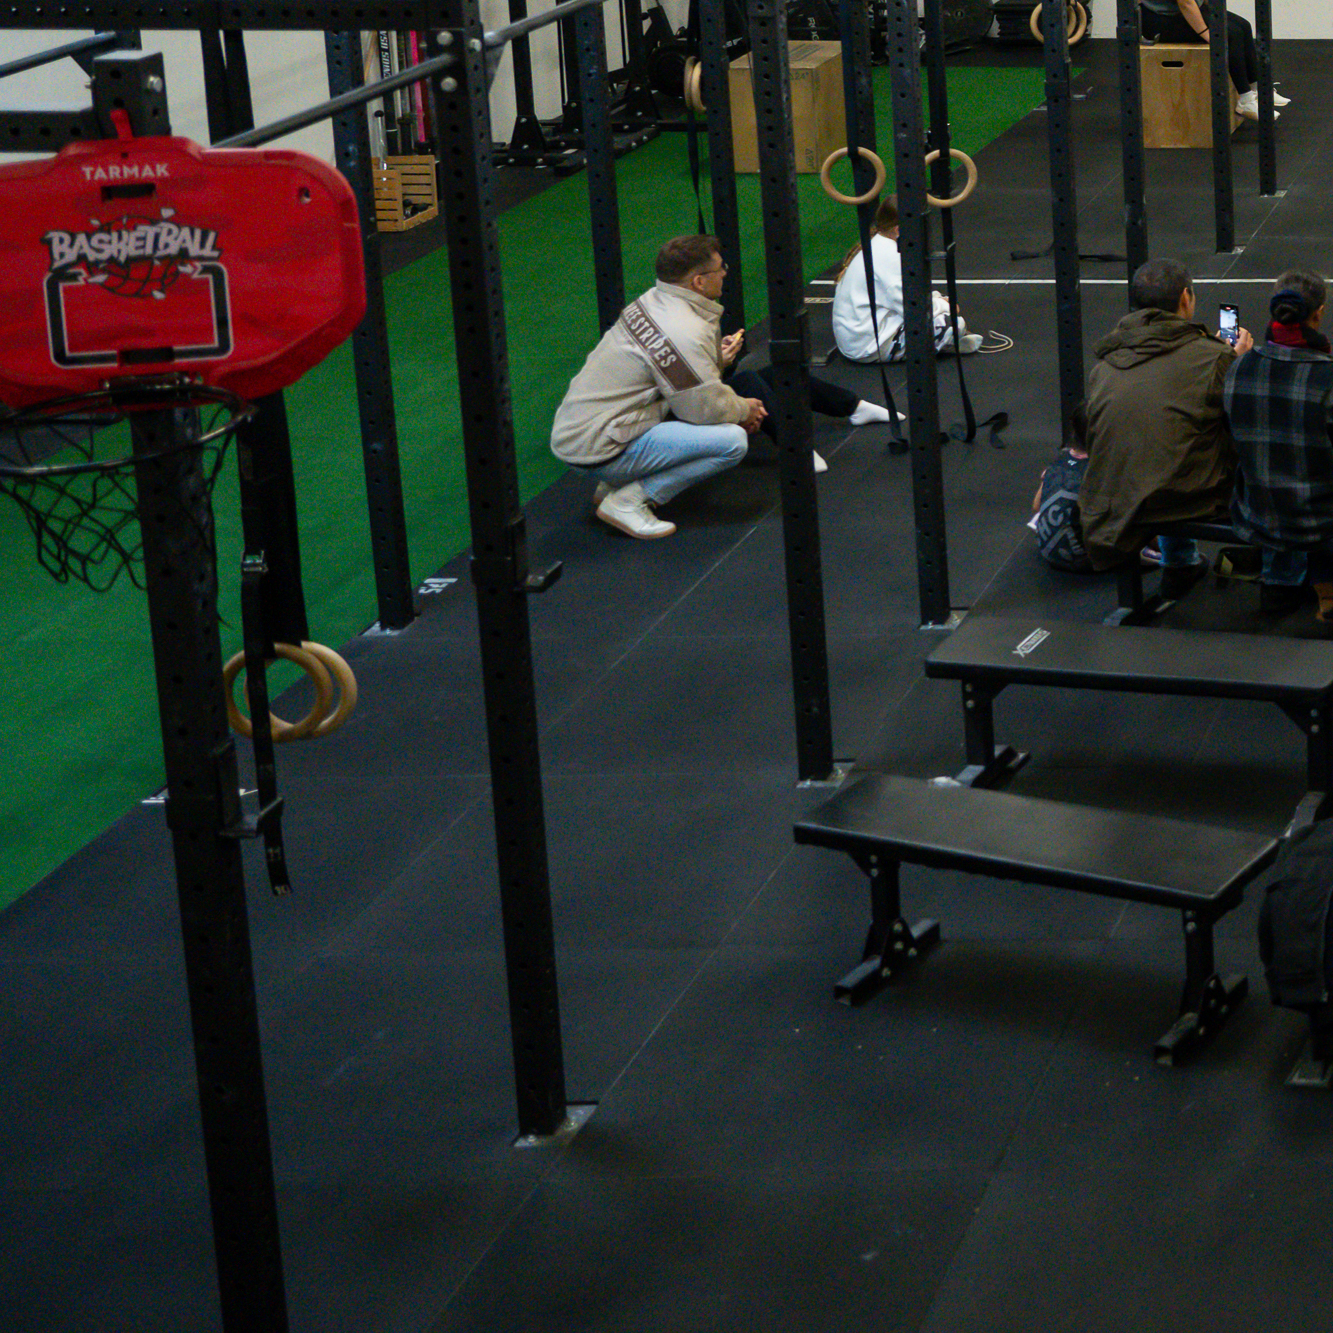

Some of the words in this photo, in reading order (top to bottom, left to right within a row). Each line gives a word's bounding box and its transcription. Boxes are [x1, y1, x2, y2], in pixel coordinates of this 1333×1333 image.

[82, 163, 170, 181] TARMAK
[43, 222, 223, 266] BASKETBALL
[631, 317, 677, 367] STRIPES
